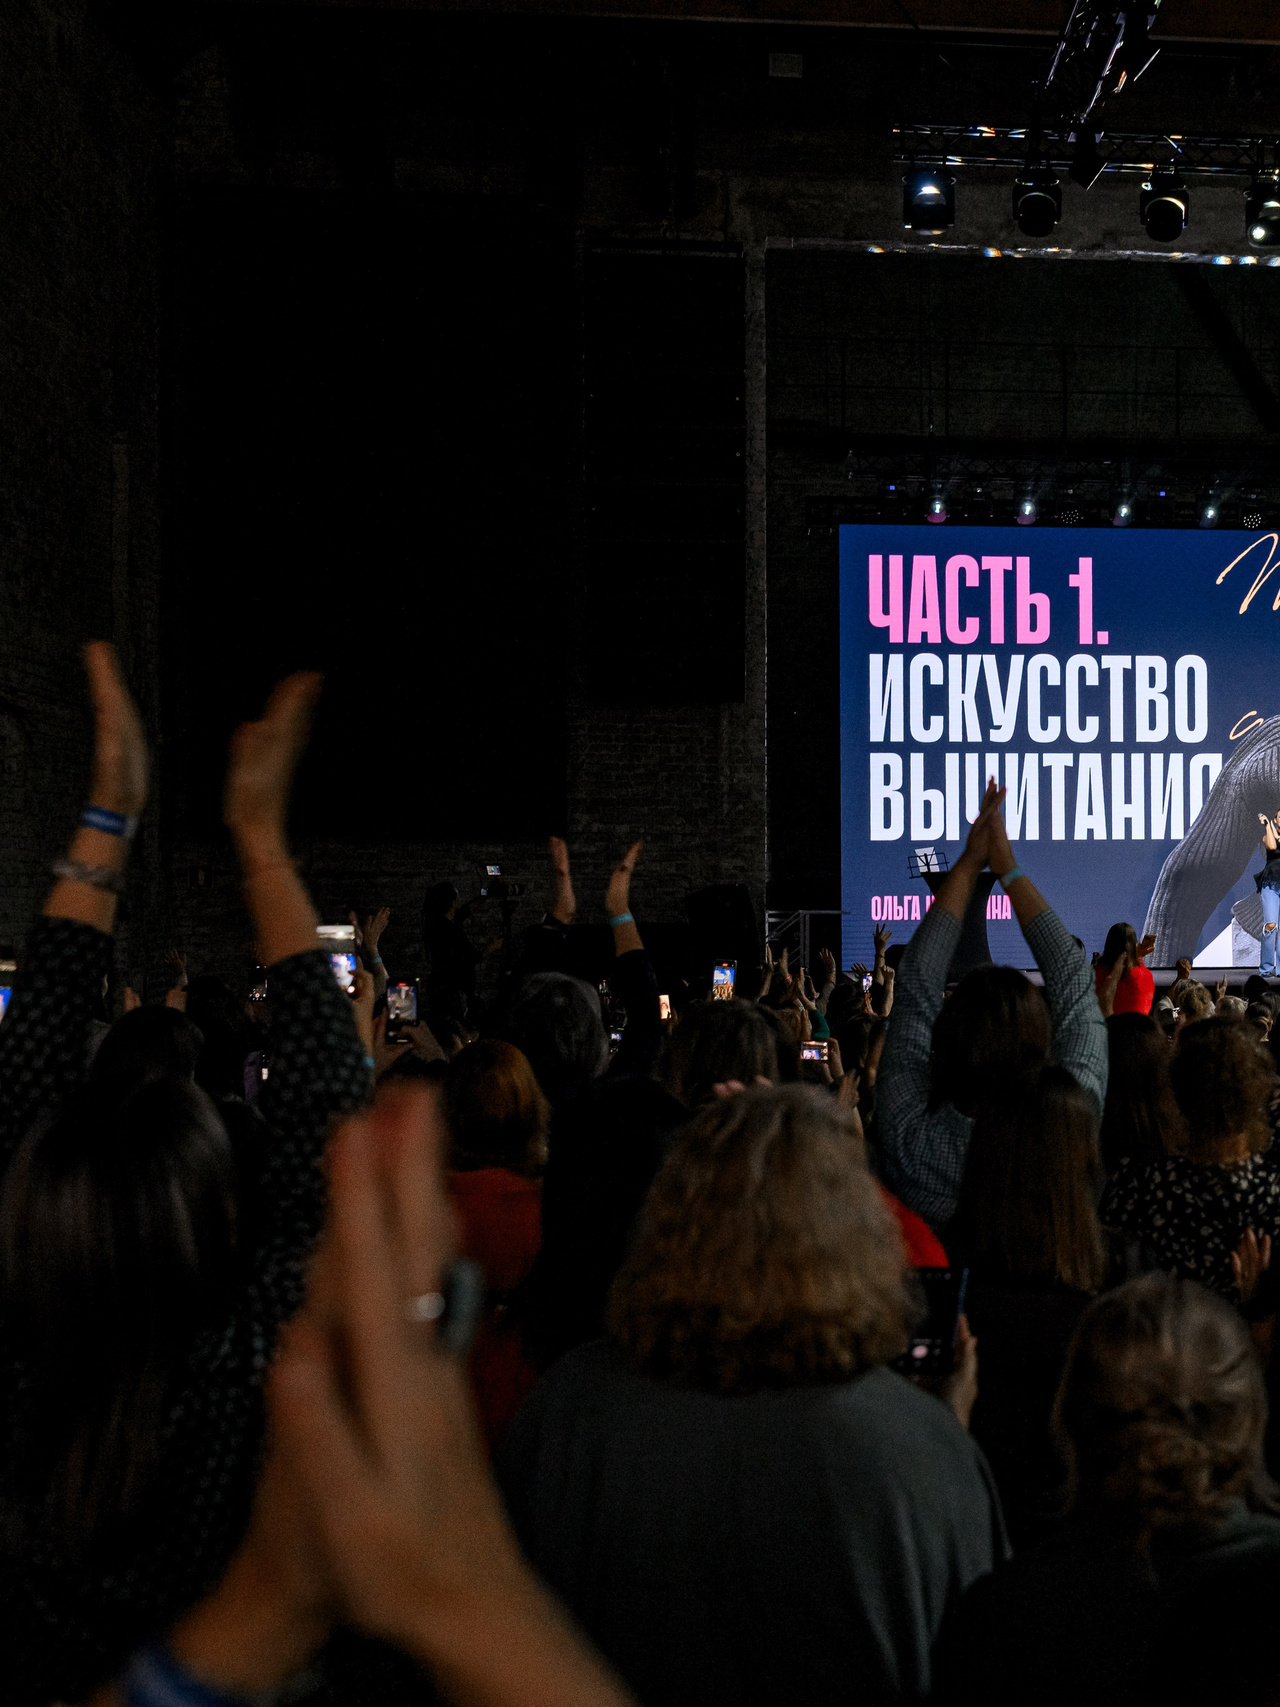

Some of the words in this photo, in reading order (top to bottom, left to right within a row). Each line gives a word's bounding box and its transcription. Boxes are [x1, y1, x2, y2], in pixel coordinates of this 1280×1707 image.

[868, 554, 1051, 645] ЧАСТЬ
[1068, 556, 1109, 645] 1.
[869, 653, 1208, 743] ИСКУССТВО
[871, 895, 921, 921] ОЛЬГА
